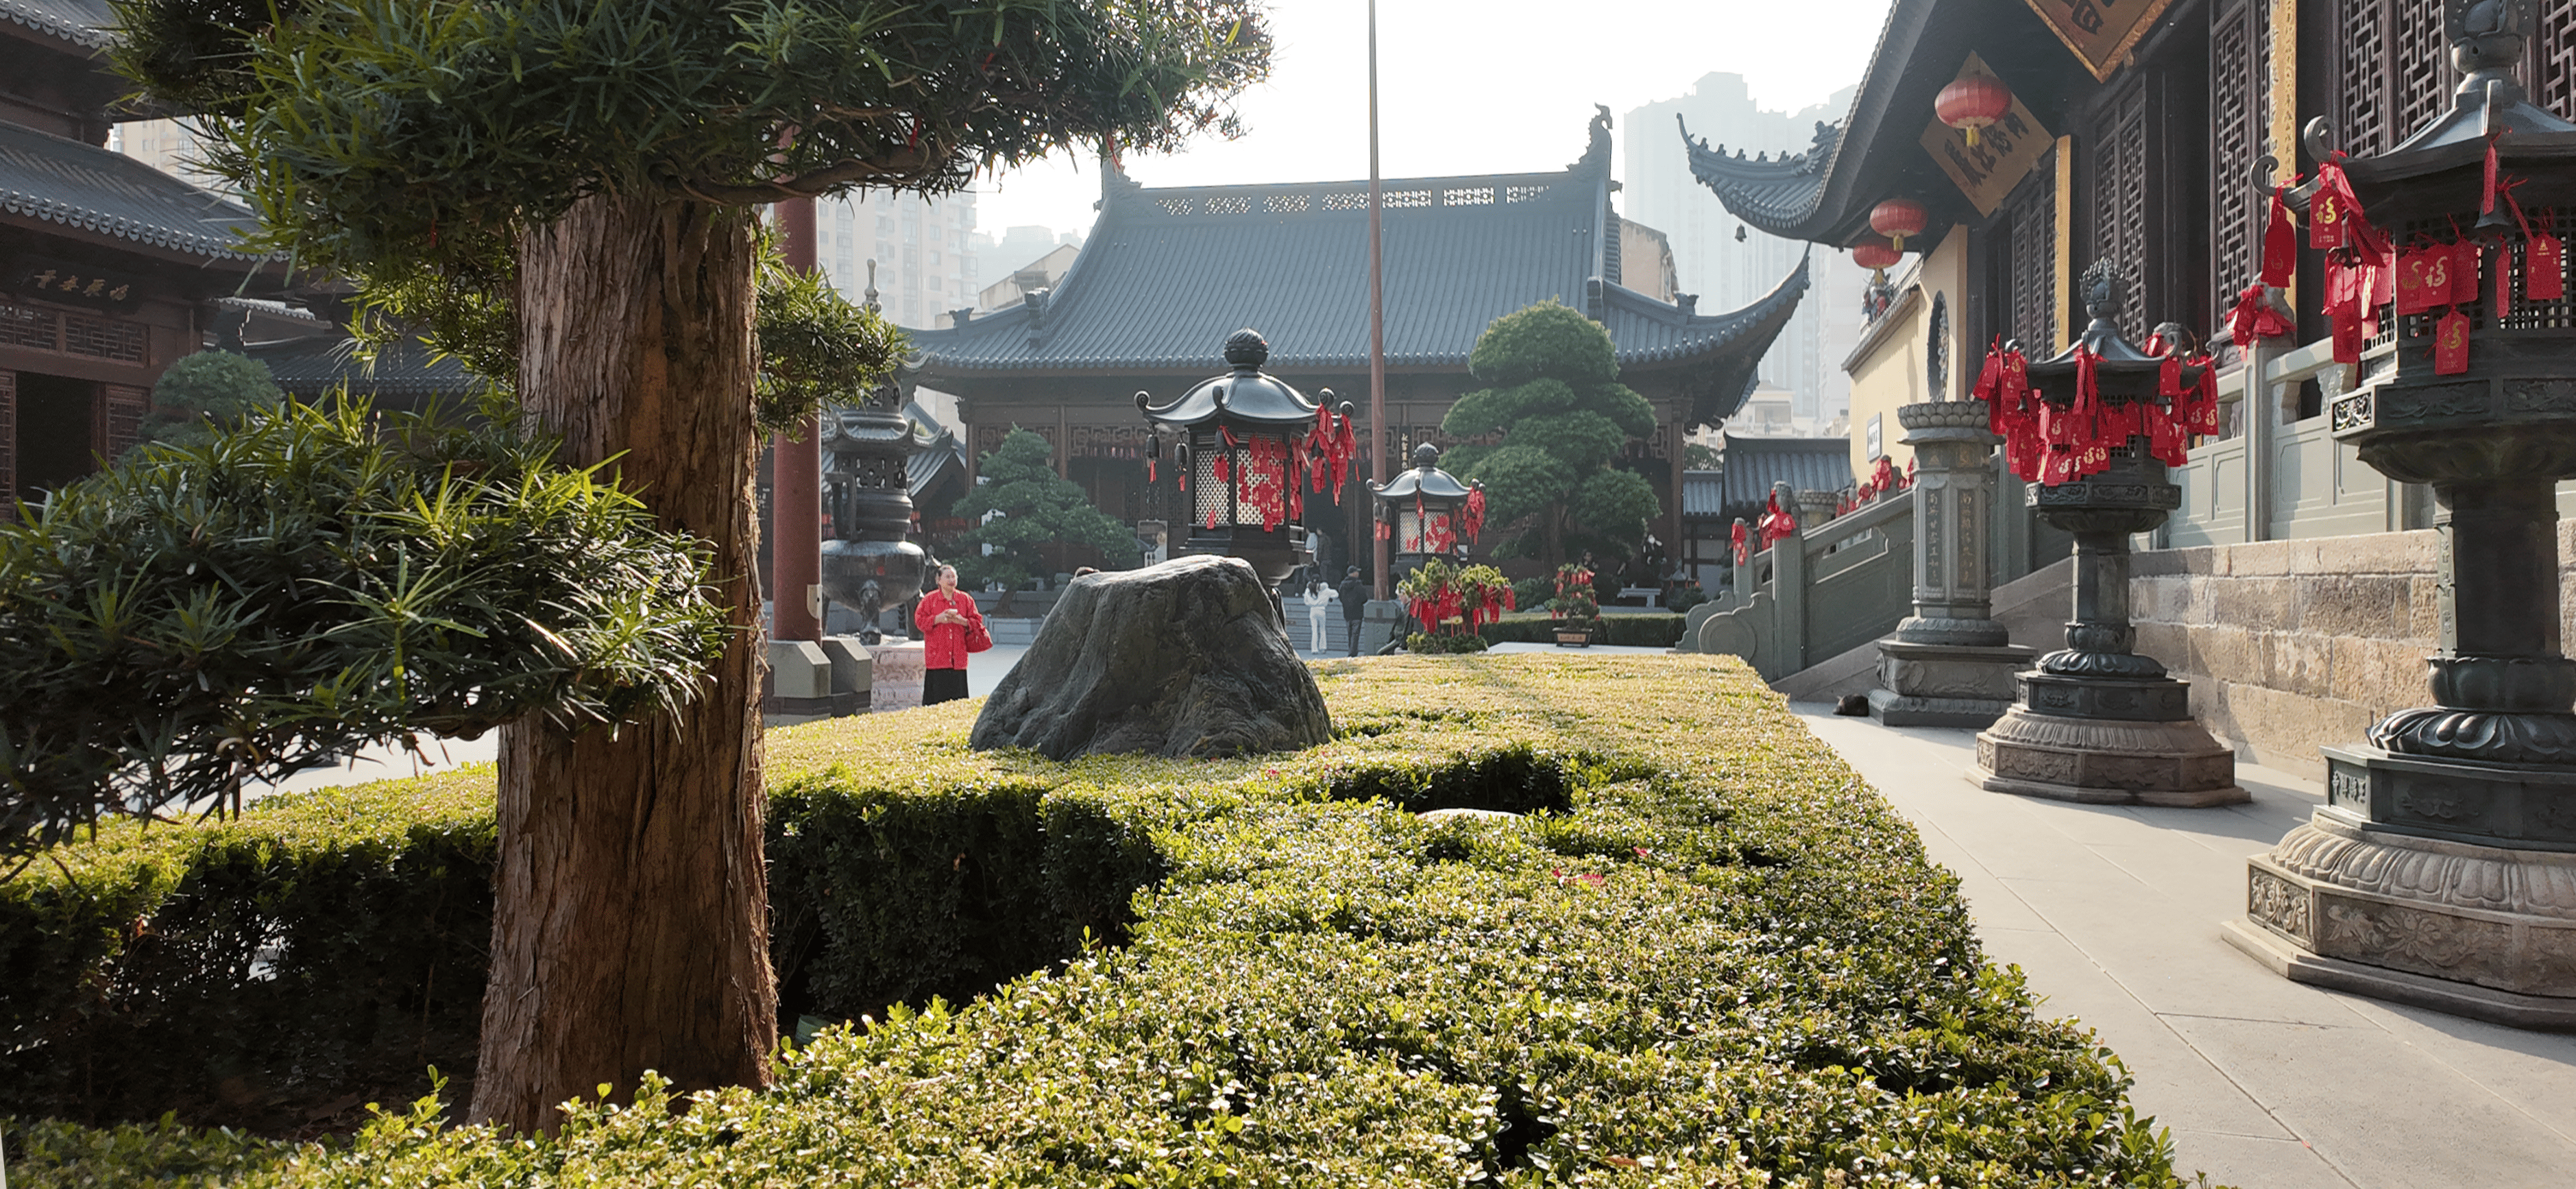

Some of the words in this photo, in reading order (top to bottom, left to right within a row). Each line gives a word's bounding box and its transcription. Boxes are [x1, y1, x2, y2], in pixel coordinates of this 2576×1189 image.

[2316, 196, 2337, 224] 福
[2425, 256, 2448, 287] 福
[2442, 321, 2464, 349] 福
